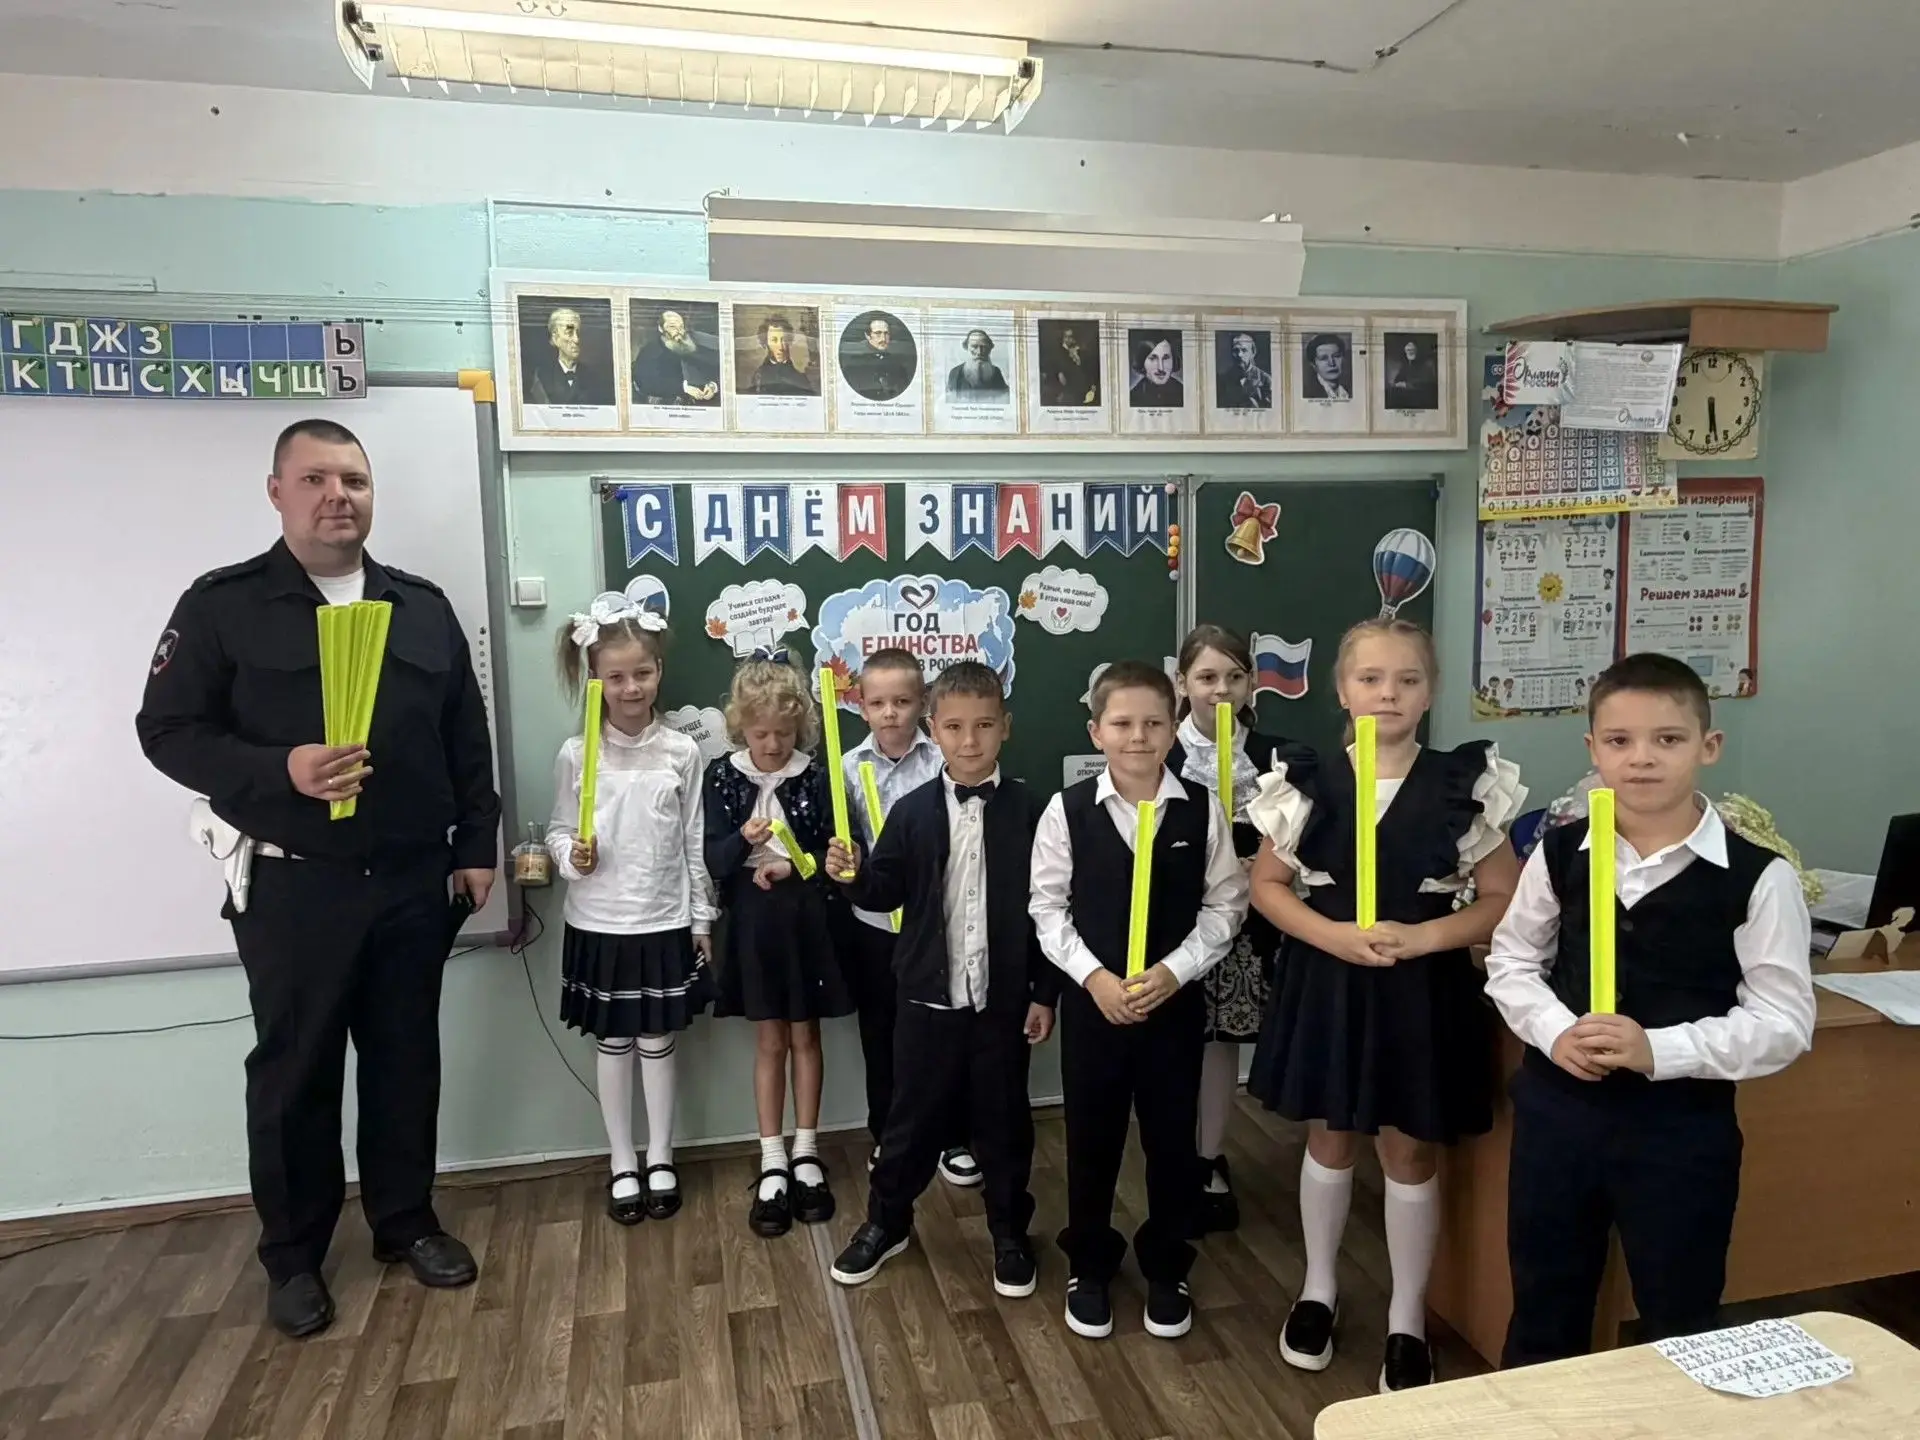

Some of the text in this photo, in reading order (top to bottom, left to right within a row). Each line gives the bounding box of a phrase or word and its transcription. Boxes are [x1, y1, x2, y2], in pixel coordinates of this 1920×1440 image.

[49, 321, 83, 355] Д
[1691, 363, 1699, 374] 11
[1708, 358, 1718, 369] 12
[1727, 363, 1733, 374] 1
[1740, 376, 1747, 388] 2
[1743, 396, 1750, 408] 3
[1735, 415, 1742, 426] 4
[1688, 429, 1696, 441] 7
[1705, 433, 1712, 445] 6
[1722, 429, 1730, 440] 5
[1488, 502, 1495, 512] 0
[1510, 500, 1518, 510] 2
[1523, 499, 1530, 509] 3
[1534, 498, 1542, 508] 4
[1547, 497, 1554, 508] 5
[1559, 496, 1566, 507] 6
[1571, 496, 1578, 507] 7
[1585, 495, 1593, 506] 8
[1600, 494, 1608, 505] 9
[1614, 494, 1627, 504] 10
[635, 484, 1159, 542] С ДНЁМ ЗНАНИЙ
[1640, 587, 1737, 601] Решаем задачи
[728, 600, 753, 610] Учимся
[754, 593, 781, 605] сегодня
[729, 602, 787, 621] создаём будущее
[749, 614, 773, 627] завтра!
[893, 612, 941, 634] ГОД
[862, 633, 979, 657] ЕДИНСТВА
[677, 719, 703, 734] ДУЩЕЕ
